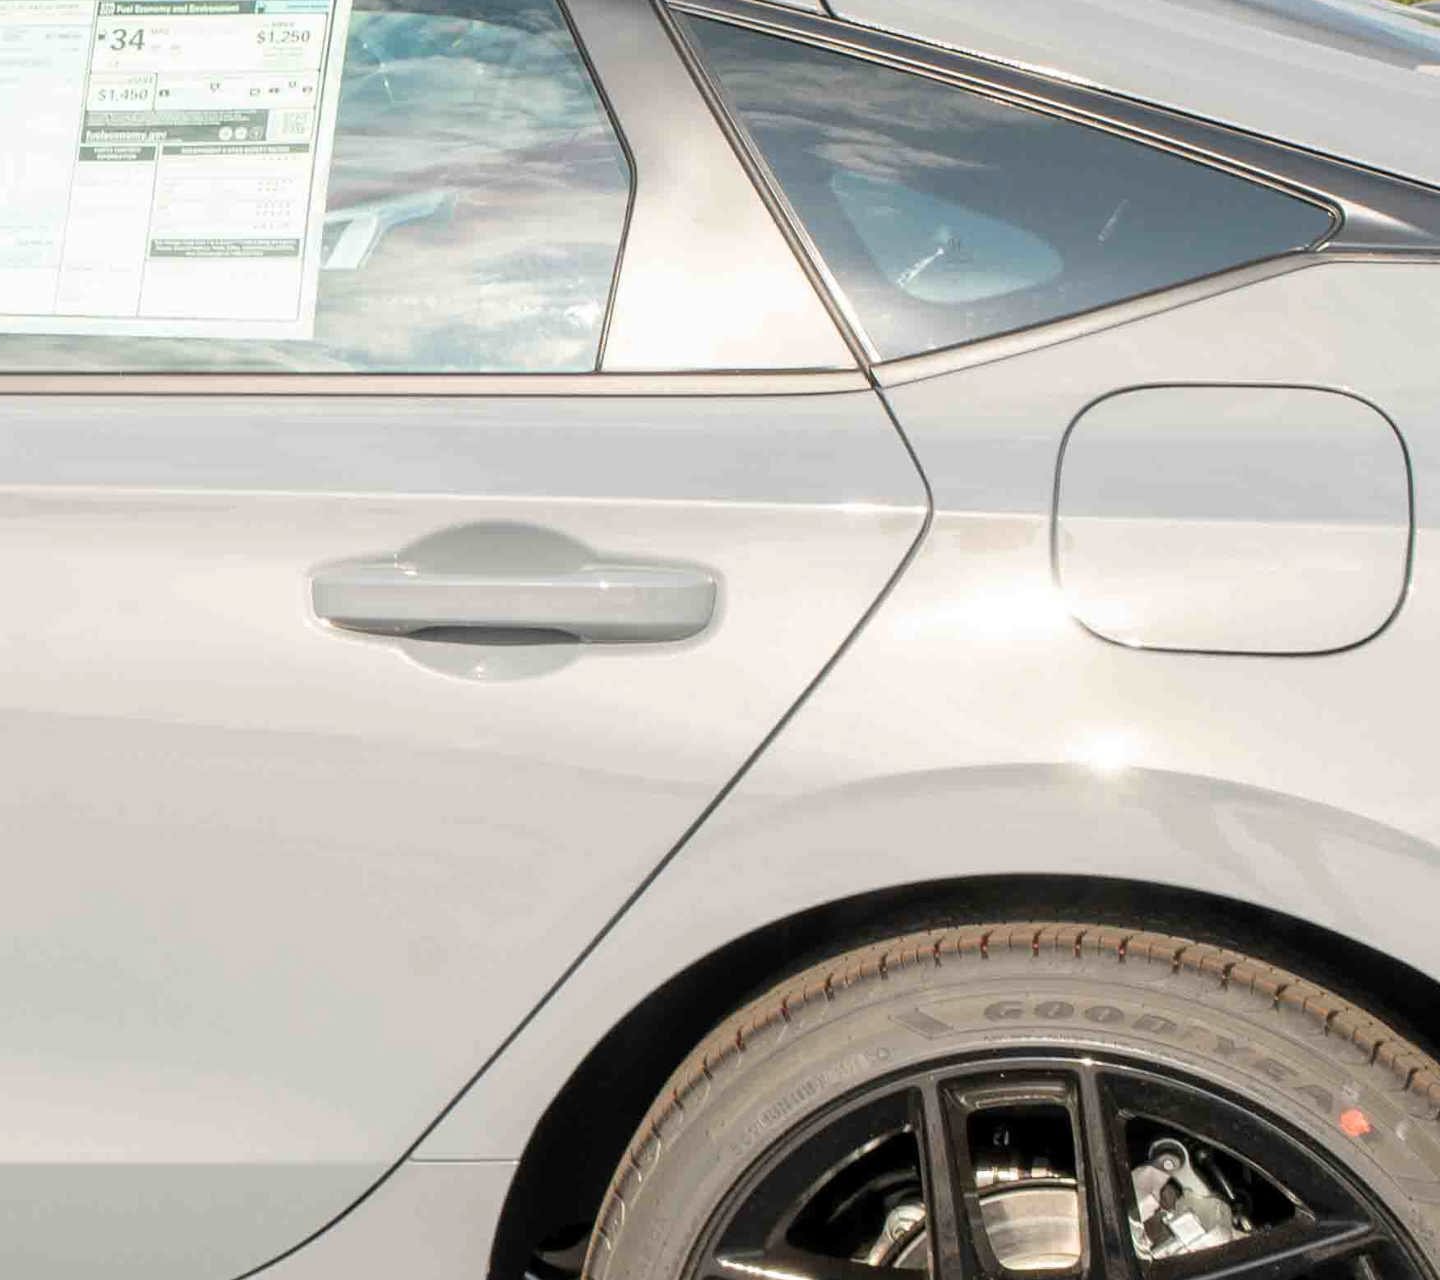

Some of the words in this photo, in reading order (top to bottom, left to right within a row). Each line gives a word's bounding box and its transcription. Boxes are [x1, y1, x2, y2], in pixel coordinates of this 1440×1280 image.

[116, 3, 134, 14] Fuel
[135, 3, 171, 15] Economy
[173, 3, 188, 14] and
[110, 28, 145, 51] 34
[256, 30, 312, 45] $1,250
